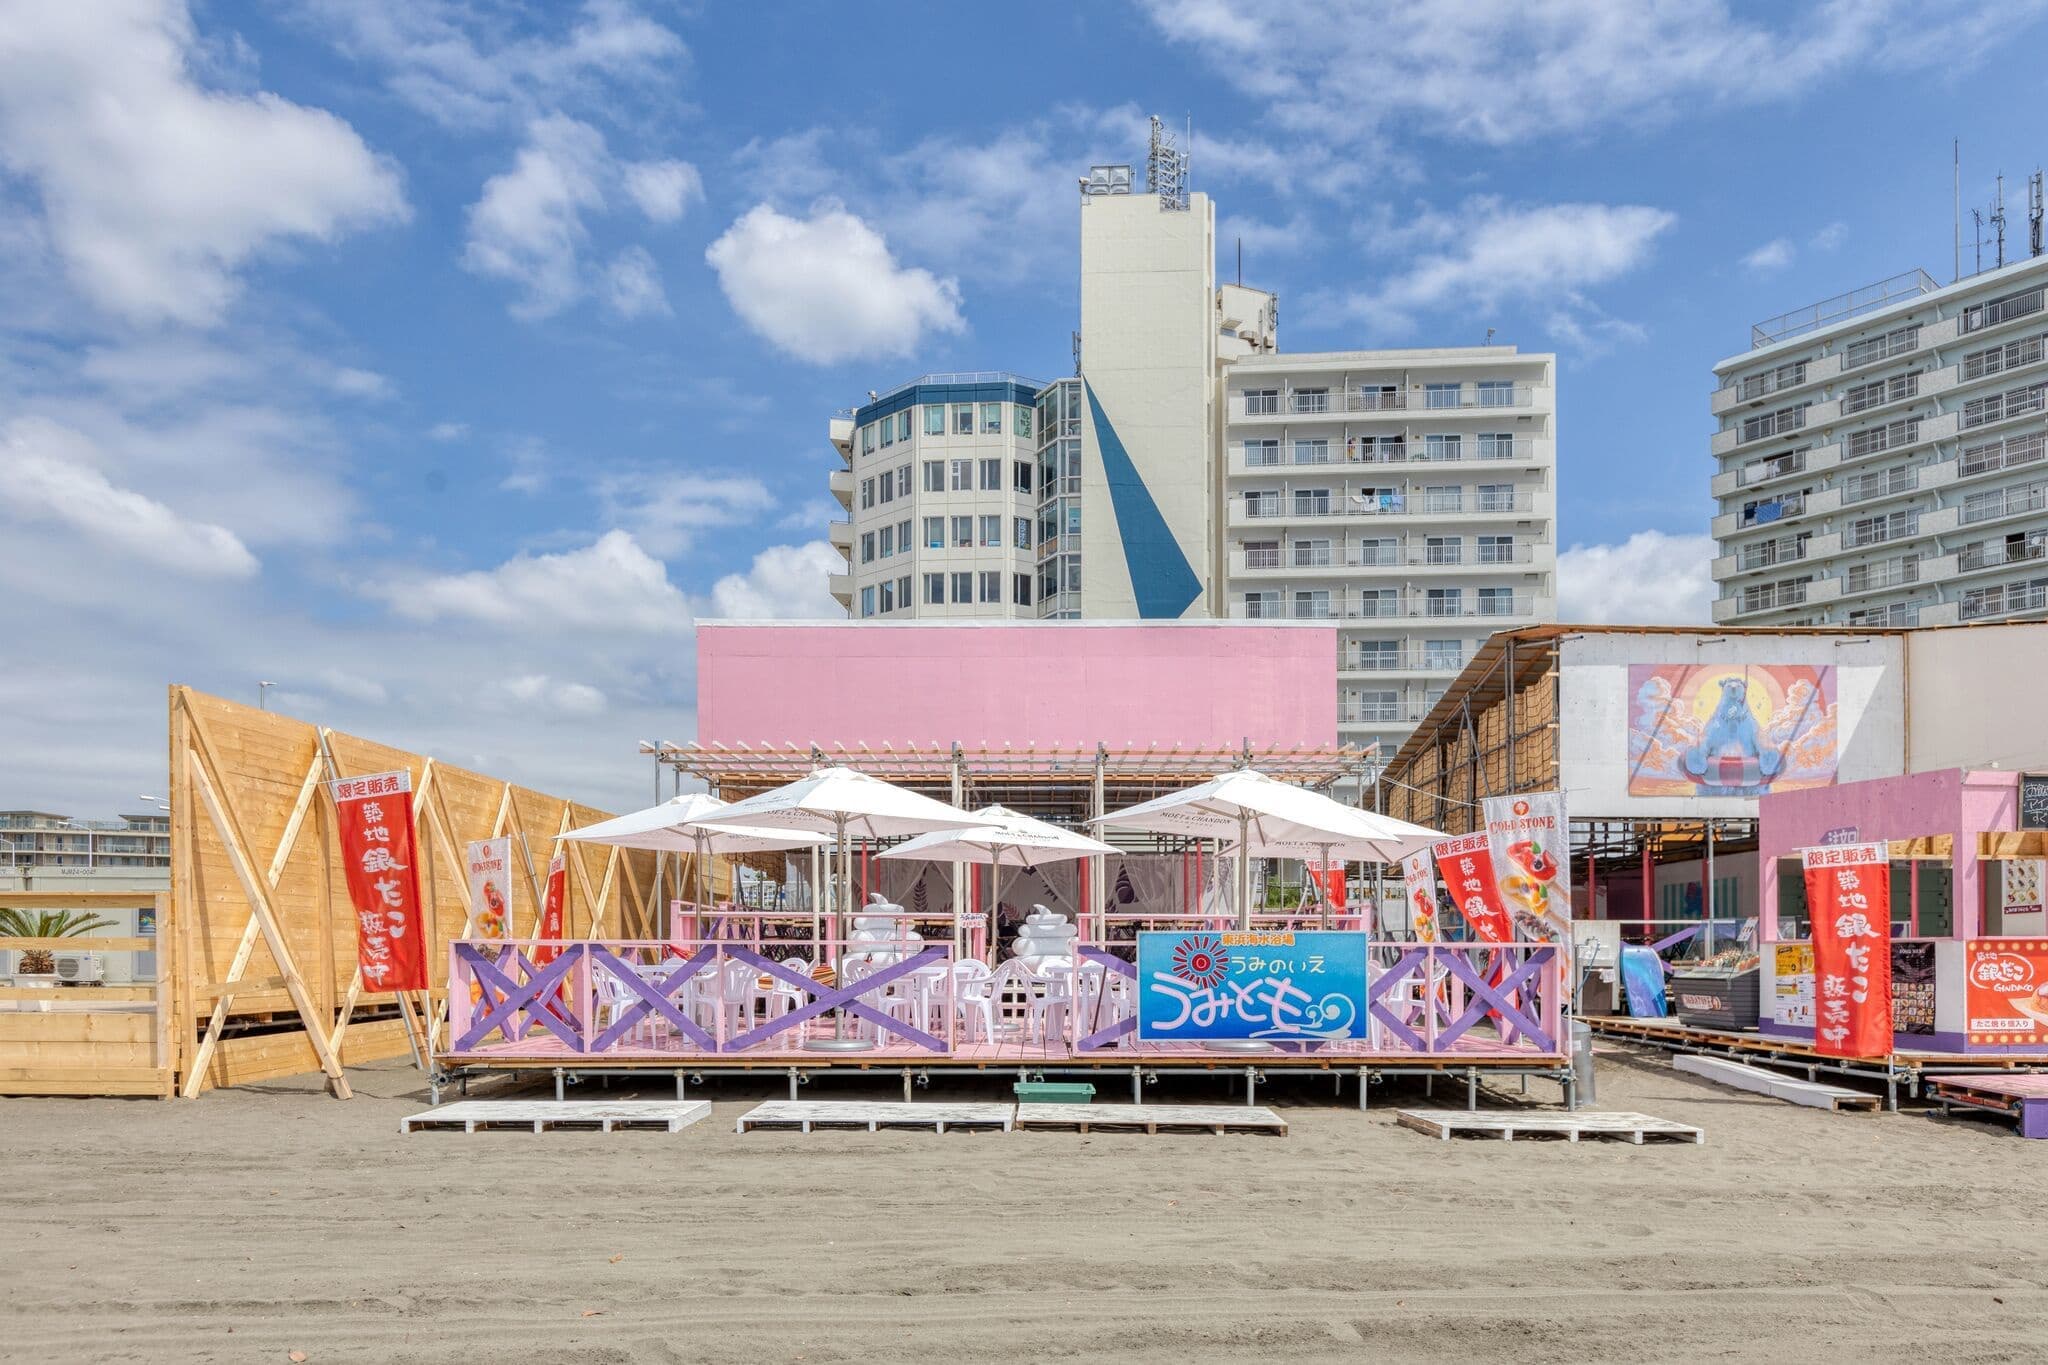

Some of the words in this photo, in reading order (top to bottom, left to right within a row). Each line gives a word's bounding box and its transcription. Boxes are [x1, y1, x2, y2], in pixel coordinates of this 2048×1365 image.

[338, 776, 399, 799] 限定販売
[1490, 820, 1517, 834] COLD
[1520, 816, 1555, 829] STONE
[1435, 835, 1488, 856] 限定販売
[1808, 848, 1876, 865] 限定販売
[362, 801, 408, 938] 築地銀だこ
[1222, 933, 1295, 946] 東浜海水浴場
[1834, 870, 1881, 1003] 築地銀だこ
[1231, 955, 1326, 975] うみのいえ
[1978, 960, 2025, 982] 銀だこ
[1821, 974, 1851, 1050] 販売中
